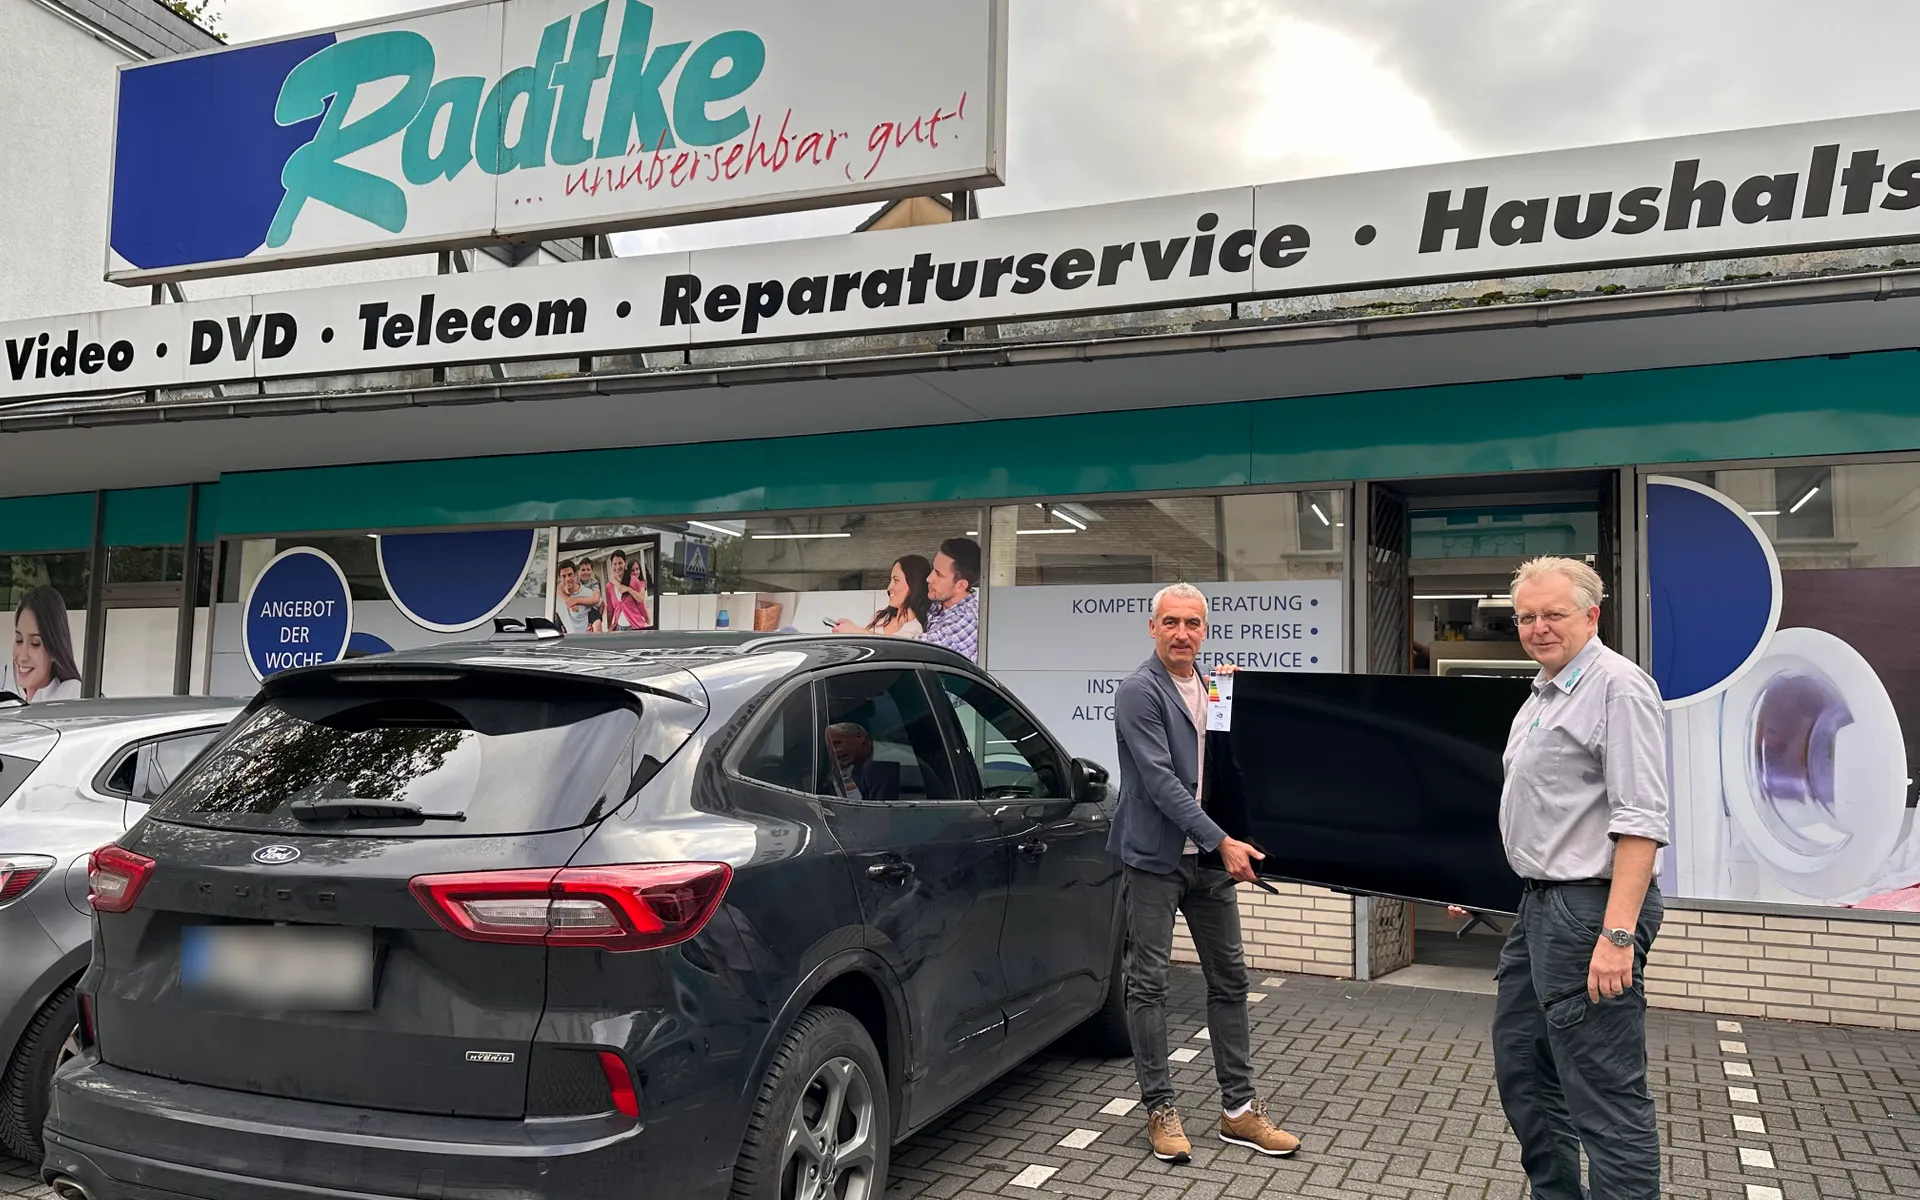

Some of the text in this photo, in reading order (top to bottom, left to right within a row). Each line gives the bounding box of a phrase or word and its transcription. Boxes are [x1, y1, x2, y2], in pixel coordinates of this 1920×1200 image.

[266, 0, 765, 248] Radtke
[845, 91, 967, 182] gut!
[5, 143, 1920, 381] Video DVD Telecom Reparaturservice Haushalts
[260, 600, 335, 618] ANGEBOT
[1072, 595, 1303, 614] KOMPETE ERATUNG
[280, 626, 310, 643] DER
[1206, 623, 1303, 641] IRE PREISE
[1087, 678, 1125, 694] INST
[1071, 705, 1116, 721] ALTG
[259, 846, 293, 861] Ford
